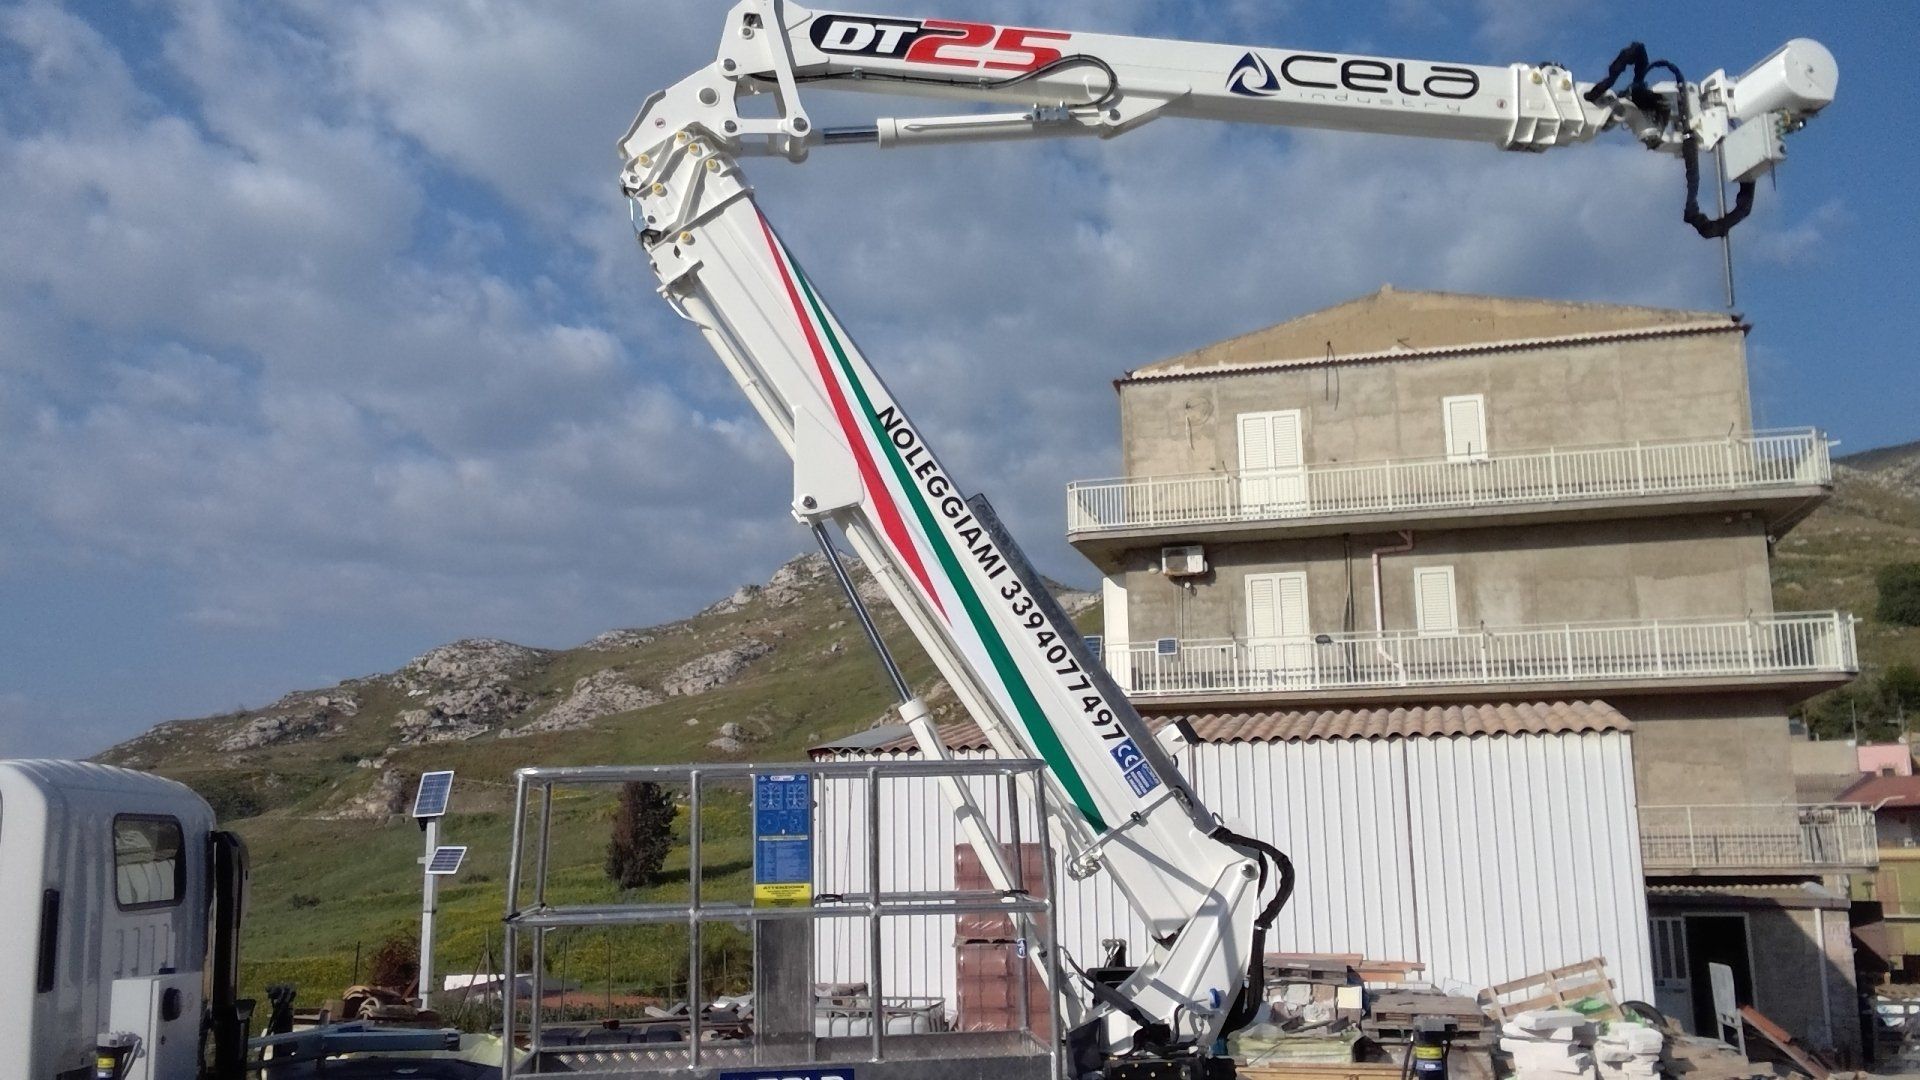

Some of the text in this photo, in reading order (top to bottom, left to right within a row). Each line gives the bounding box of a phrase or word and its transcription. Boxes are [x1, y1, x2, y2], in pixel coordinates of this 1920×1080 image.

[1299, 92, 1461, 113] industry
[877, 406, 1124, 741] NOLEGGIAMI 3394077497
